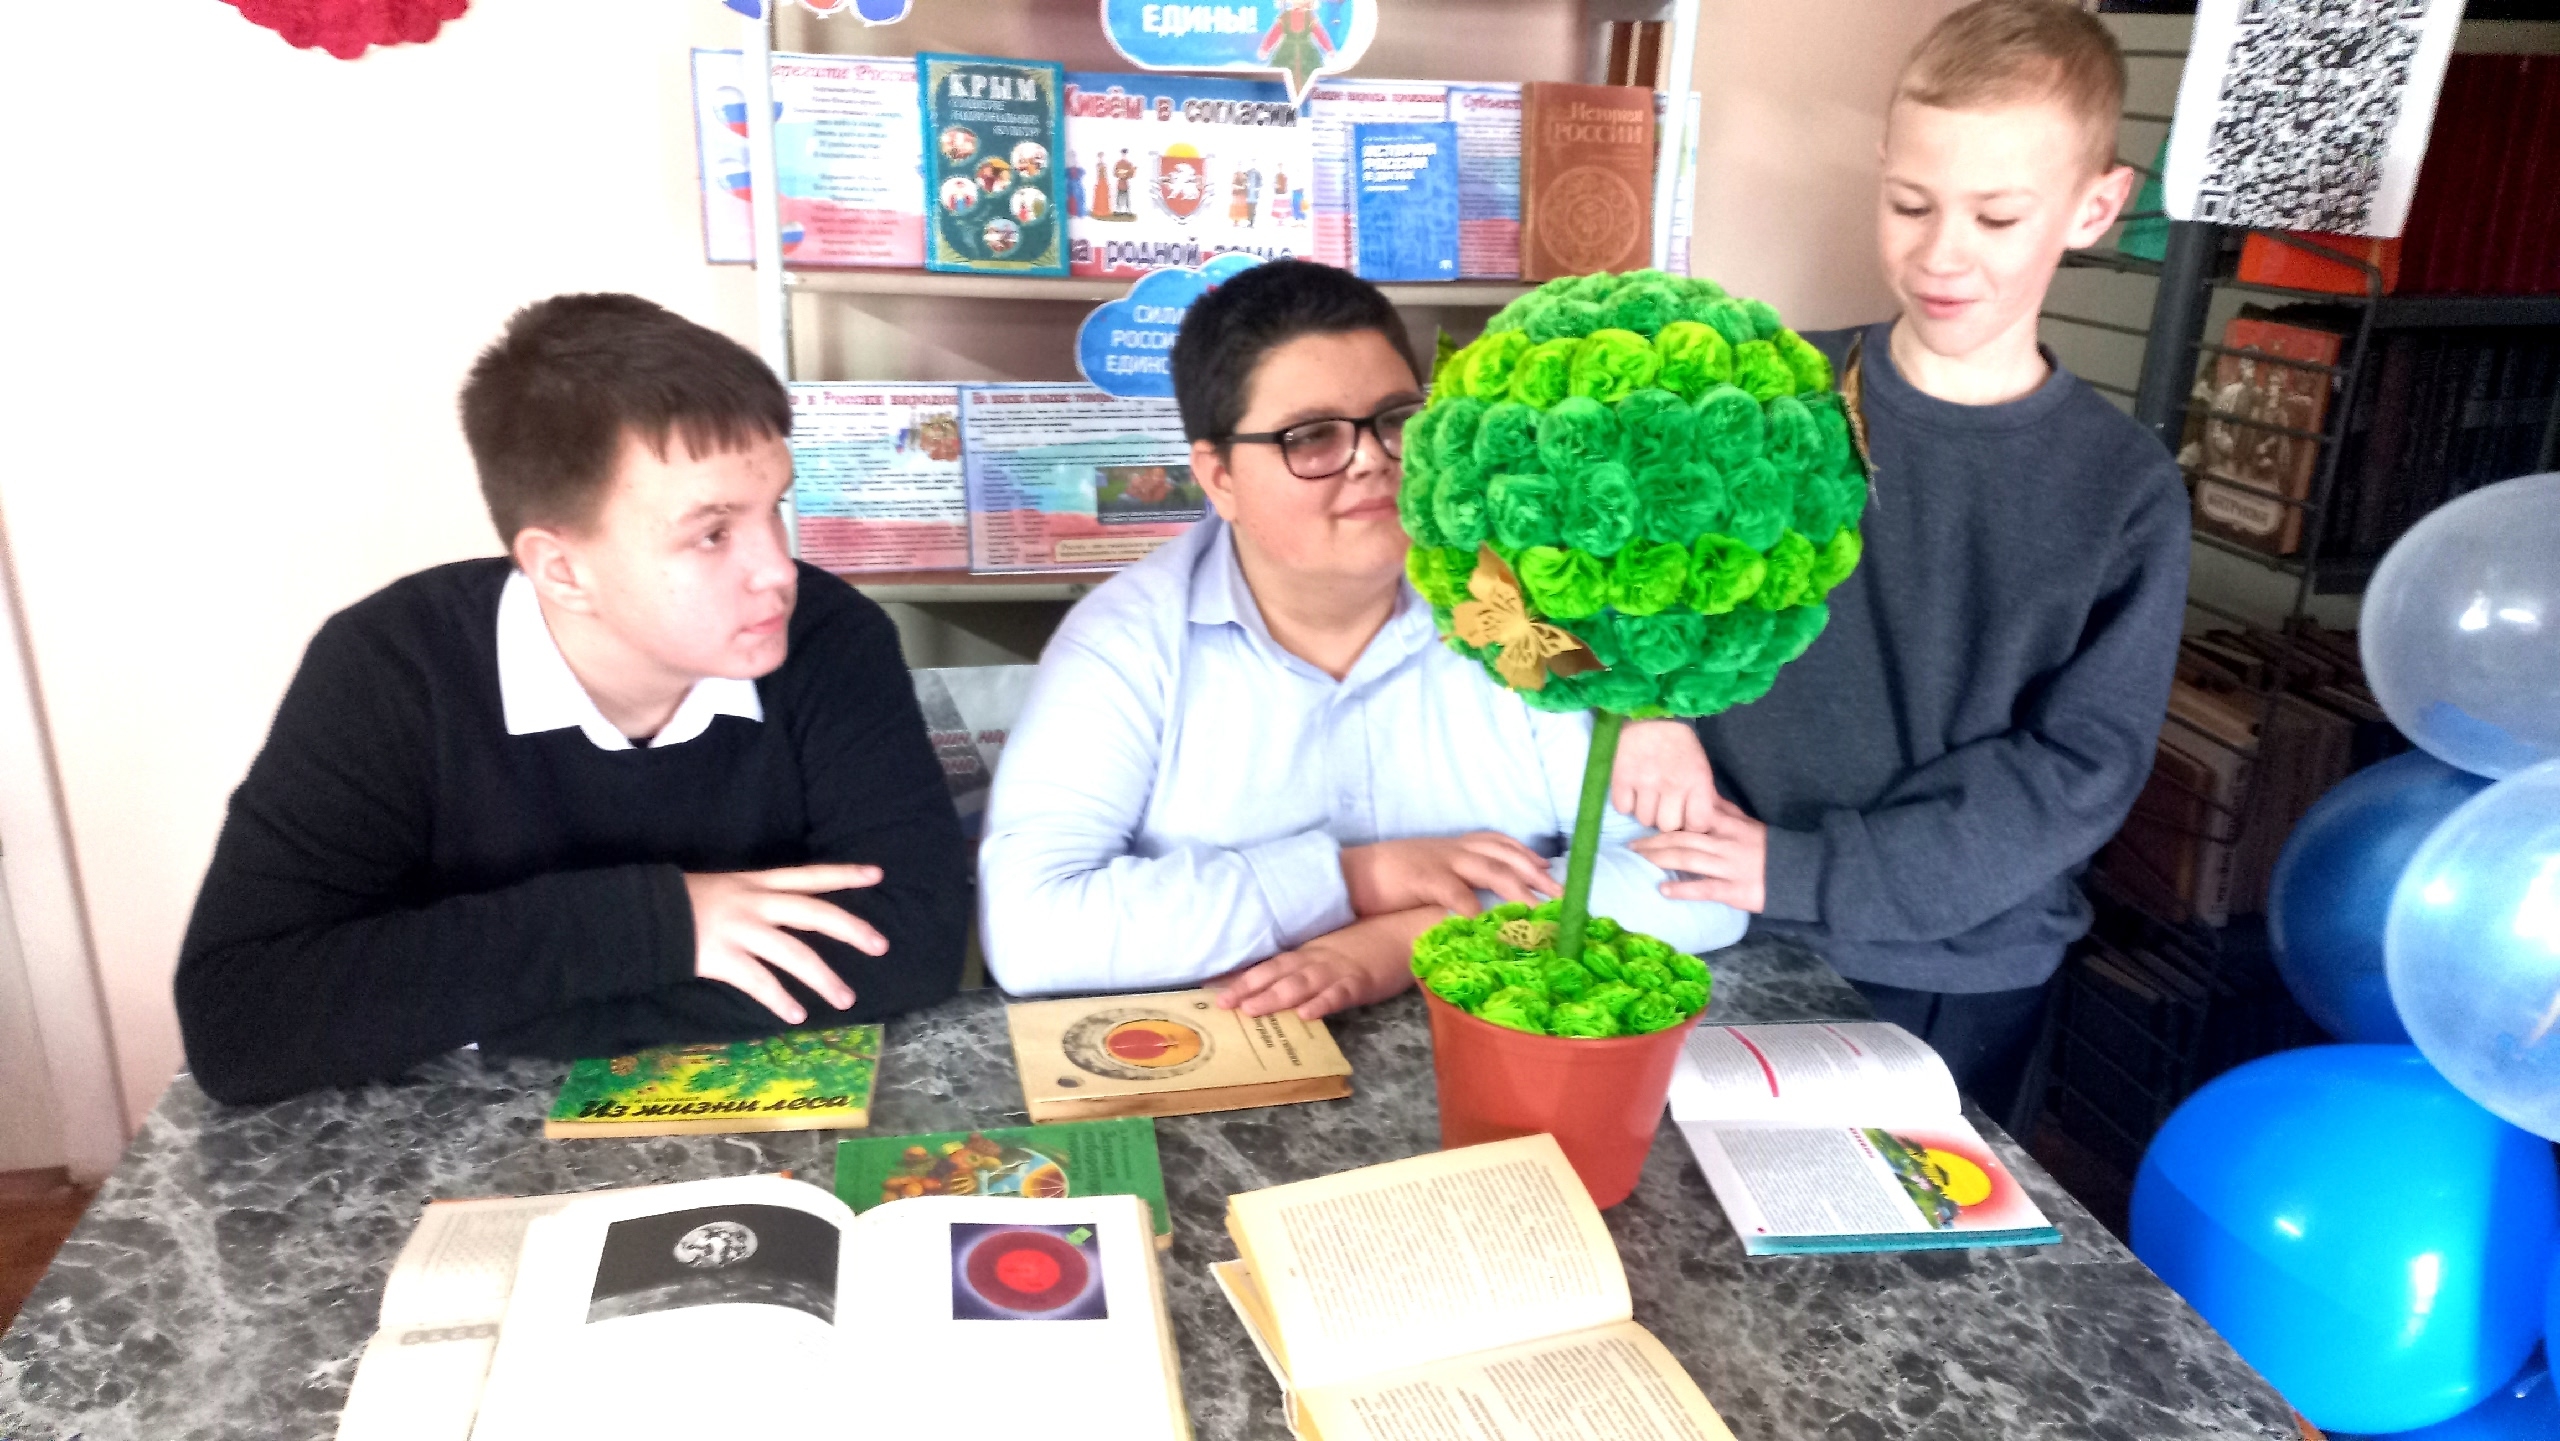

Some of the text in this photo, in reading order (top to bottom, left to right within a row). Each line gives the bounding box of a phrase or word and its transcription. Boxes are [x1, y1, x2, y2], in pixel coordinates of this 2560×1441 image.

[1142, 3, 1259, 38] ЕДИНЫ!
[948, 74, 1038, 101] КРЫМ
[1155, 97, 1173, 121] в
[1184, 99, 1298, 127] согласии
[1570, 101, 1644, 125] История
[1554, 122, 1644, 144] РОССИИ
[1105, 235, 1200, 272] родной
[1110, 329, 1179, 350] РОССИ
[577, 1099, 630, 1118] Из
[631, 1098, 759, 1117] жизни
[763, 1095, 851, 1112] леса
